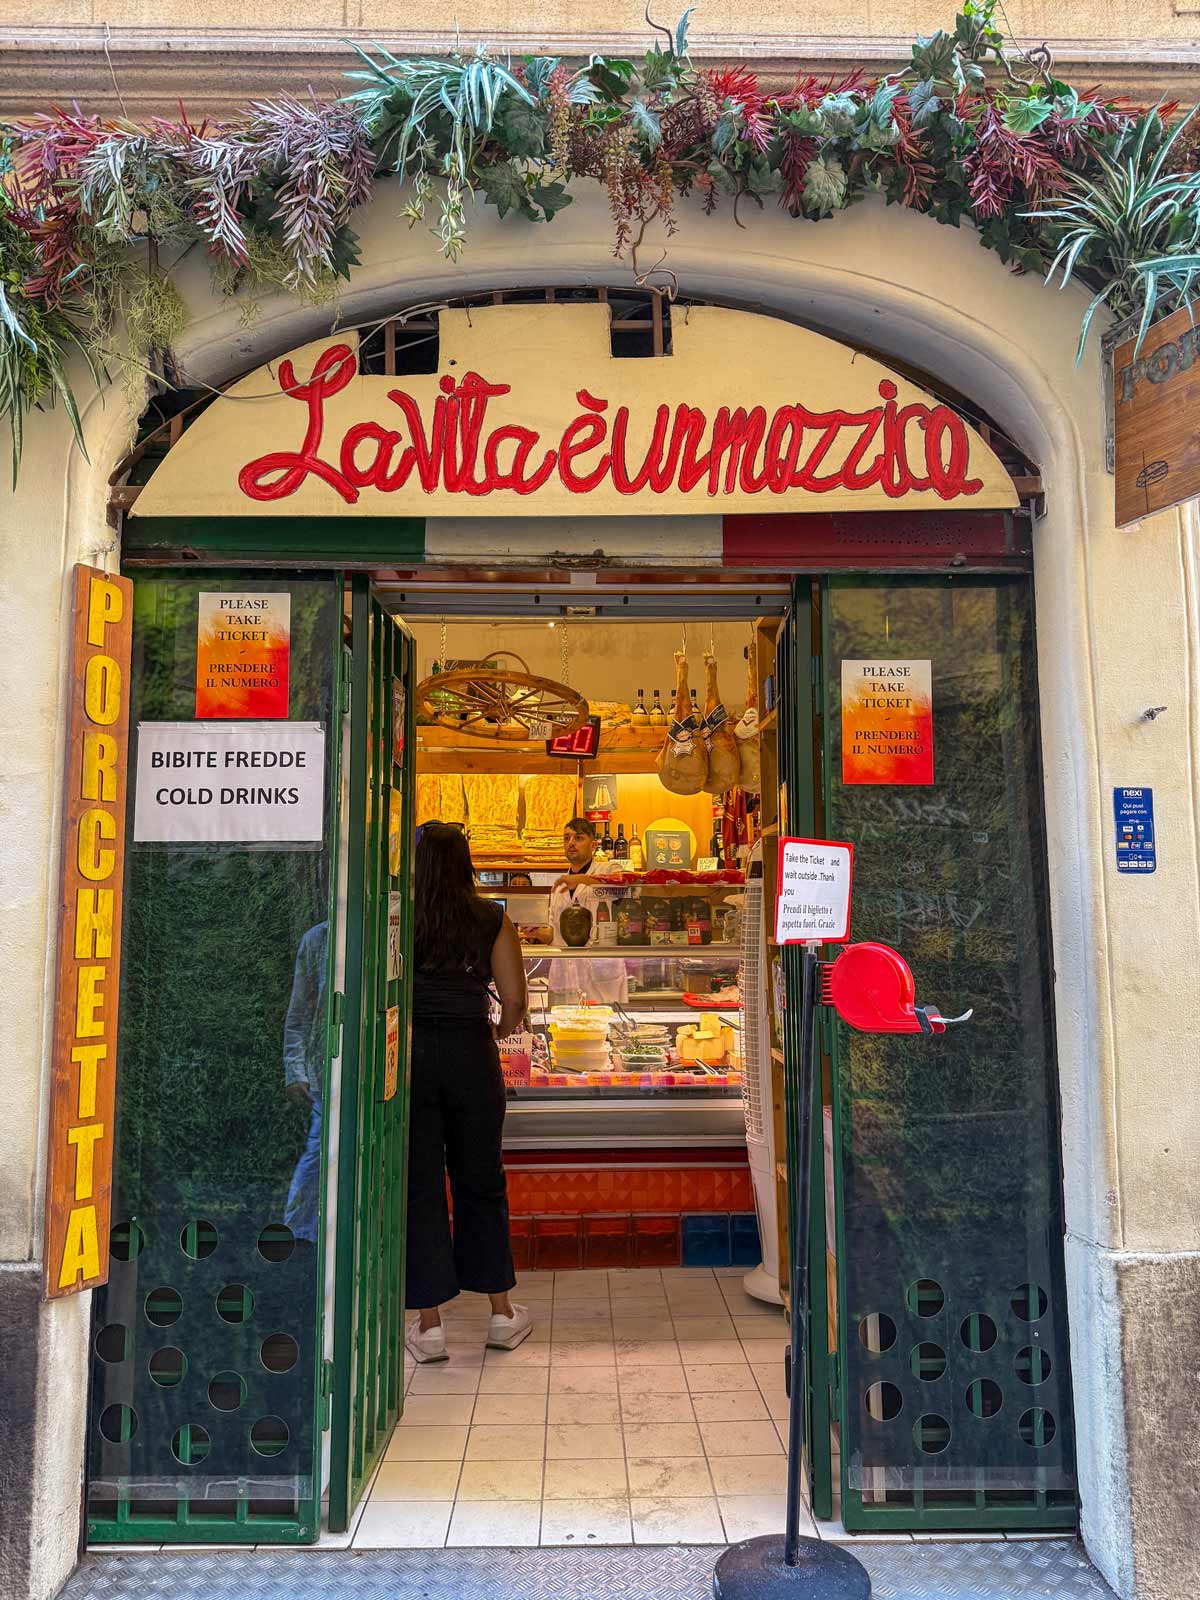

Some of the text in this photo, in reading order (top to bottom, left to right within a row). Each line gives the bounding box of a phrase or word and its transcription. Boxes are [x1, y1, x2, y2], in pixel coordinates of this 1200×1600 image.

[239, 344, 416, 503] La
[387, 372, 557, 496] Vita
[220, 599, 269, 609] PLEASE
[226, 615, 262, 625] TAKE
[218, 631, 269, 641] TICKET
[209, 663, 276, 673] PRENDERE
[863, 667, 911, 677] PLEASE
[206, 678, 279, 688] IL NUMERO
[869, 682, 905, 692] TAKE
[861, 698, 912, 709] TICKET
[855, 731, 921, 740] PRENDERE
[852, 745, 924, 754] IL NUMERO
[151, 751, 307, 769] BIBITE FREDDE
[156, 787, 300, 805] COLD DRINKS
[1122, 789, 1143, 797] nexi
[785, 853, 841, 867] Take the Ticket and
[785, 871, 797, 880] wait
[798, 871, 818, 881] outside
[784, 888, 795, 897] you
[783, 904, 802, 914] Prendi
[802, 904, 807, 914] il
[808, 905, 828, 916] biglietto
[782, 919, 802, 931] aspetta
[818, 919, 836, 929] Grazie
[58, 576, 123, 1289] PORCHETTA
